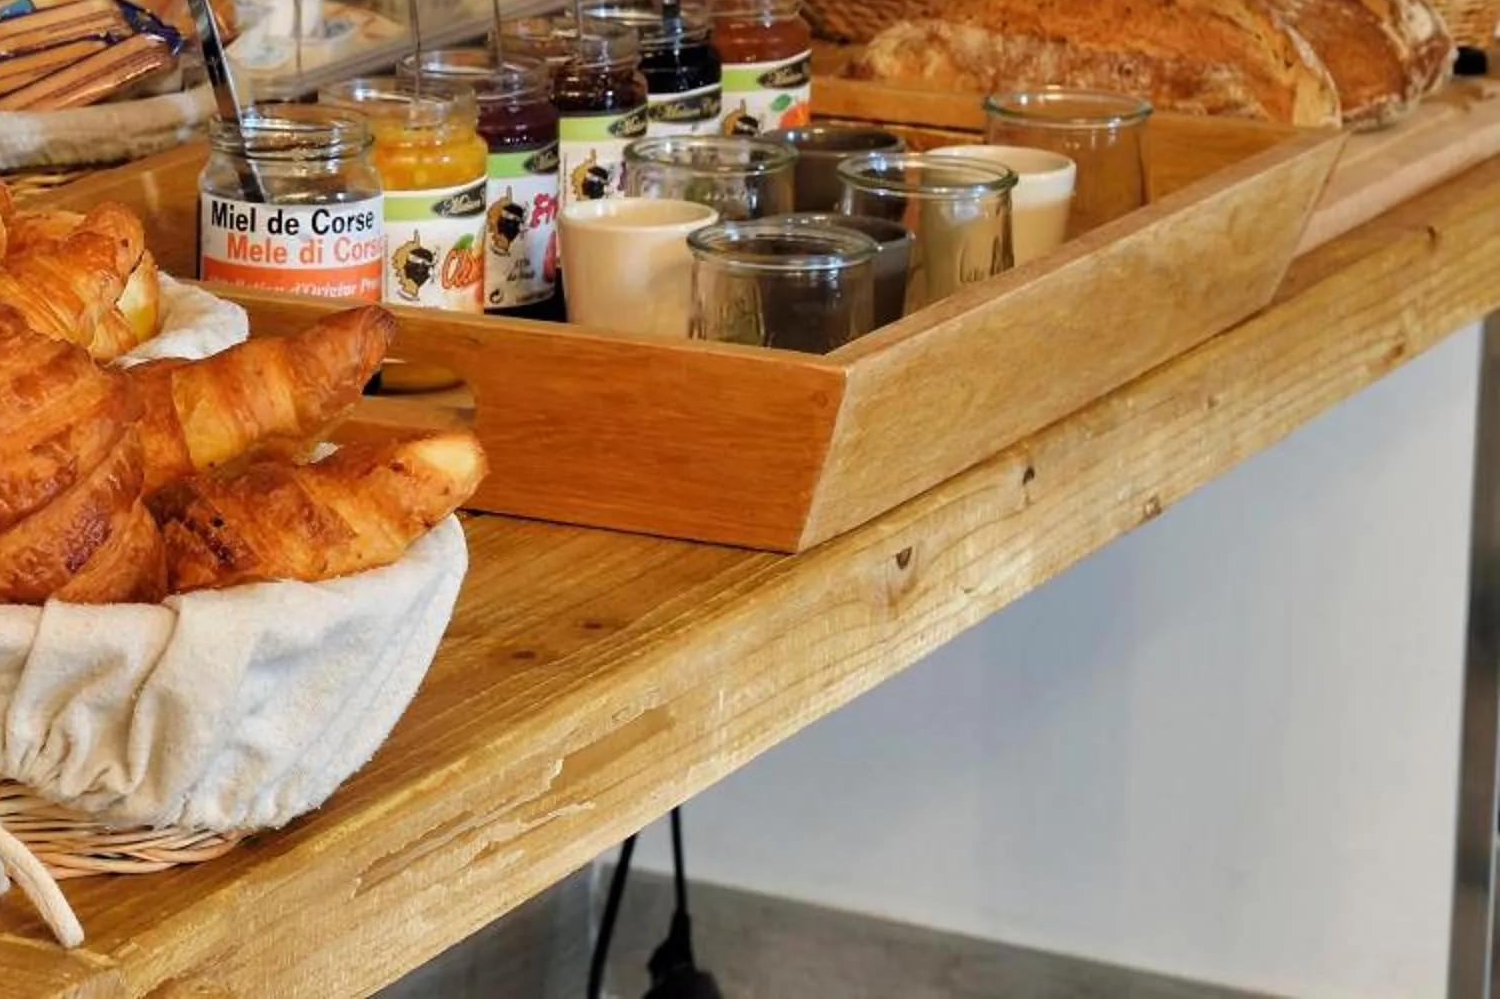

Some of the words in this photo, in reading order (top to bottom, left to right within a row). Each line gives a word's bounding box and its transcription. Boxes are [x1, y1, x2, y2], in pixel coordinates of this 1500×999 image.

[211, 200, 256, 232] Miel
[267, 208, 299, 235] de
[311, 208, 375, 235] Corse
[227, 232, 287, 264] Mele
[299, 238, 324, 264] di
